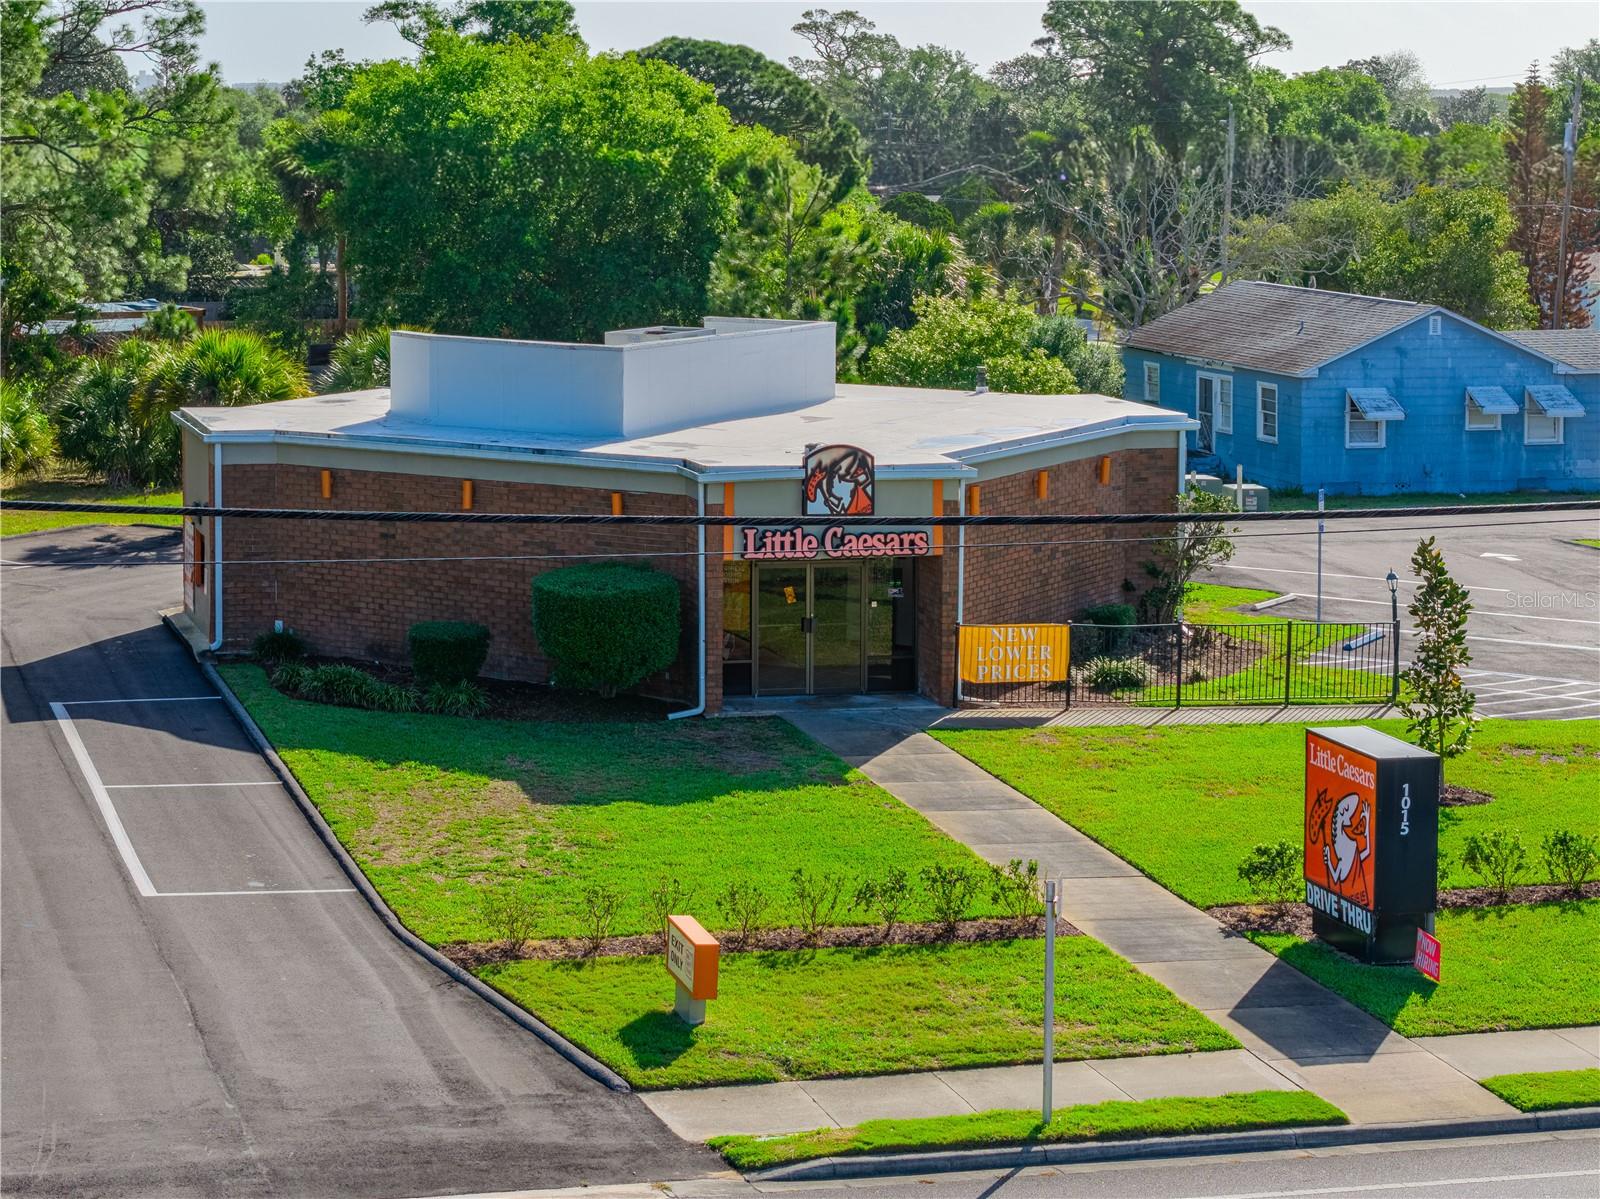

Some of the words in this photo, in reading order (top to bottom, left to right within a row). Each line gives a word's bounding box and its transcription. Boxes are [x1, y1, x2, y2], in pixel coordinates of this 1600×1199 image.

[743, 527, 818, 559] Little
[823, 526, 929, 558] Caesars
[991, 627, 1038, 642] NEW
[977, 645, 1051, 661] LOWER
[977, 664, 1051, 681] PRICES
[1309, 743, 1336, 773] Little
[1336, 754, 1375, 789] Caesars
[1400, 783, 1411, 835] 1015
[1306, 882, 1338, 919] DRIVE
[1341, 898, 1371, 935] THRU
[671, 934, 684, 955] EXIT
[1421, 935, 1437, 957] NOW
[670, 951, 683, 971] ONLY
[1416, 952, 1439, 977] HIRING
